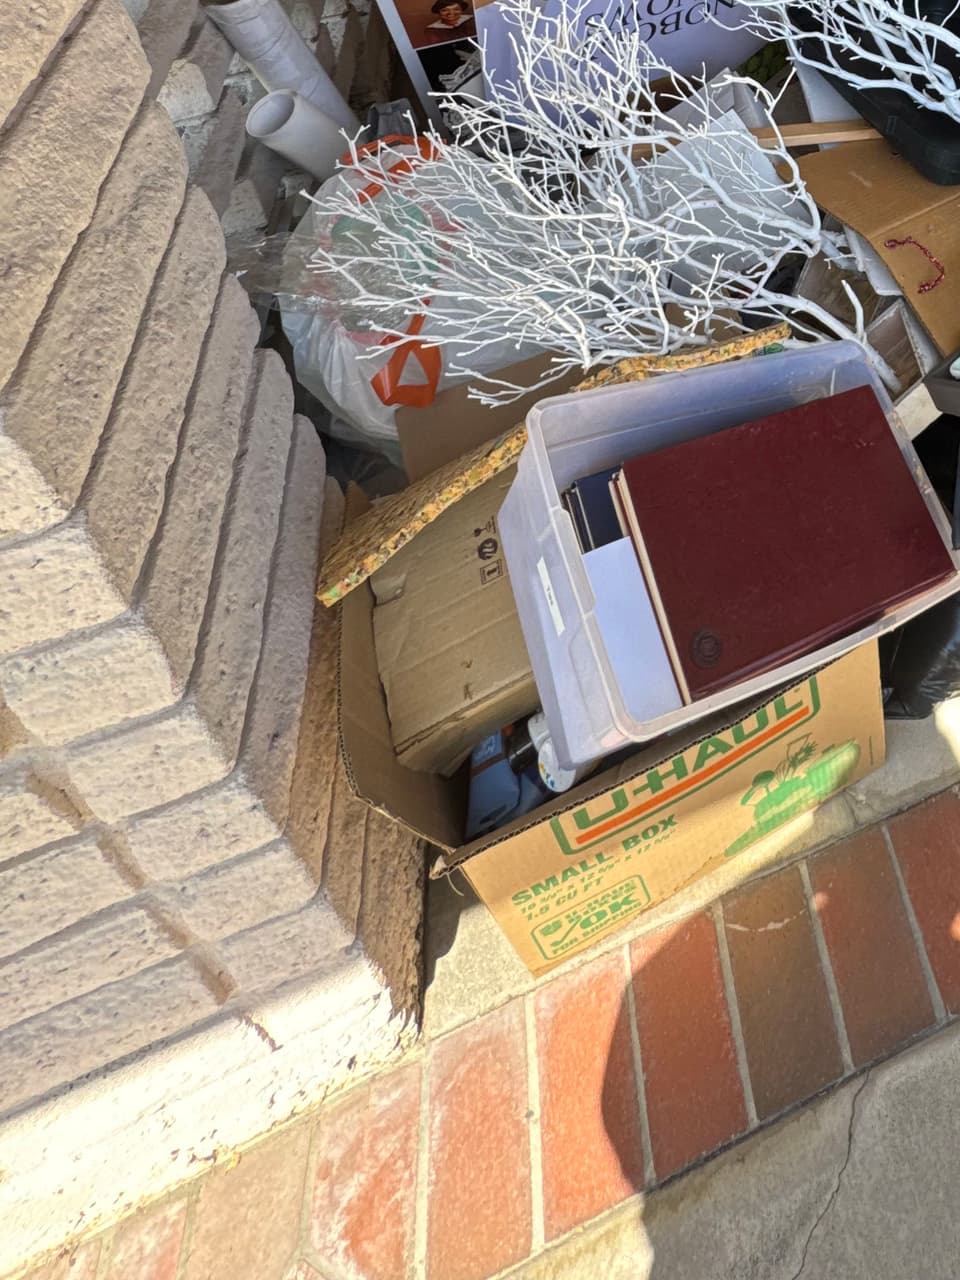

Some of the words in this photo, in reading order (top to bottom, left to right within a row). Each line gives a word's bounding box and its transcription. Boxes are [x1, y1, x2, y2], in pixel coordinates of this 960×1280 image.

[572, 687, 804, 830] U-HAUL
[511, 851, 616, 906] SMALL
[621, 814, 678, 851] BOX
[555, 889, 579, 907] CU
[582, 875, 605, 892] FT
[578, 892, 640, 930] OK
